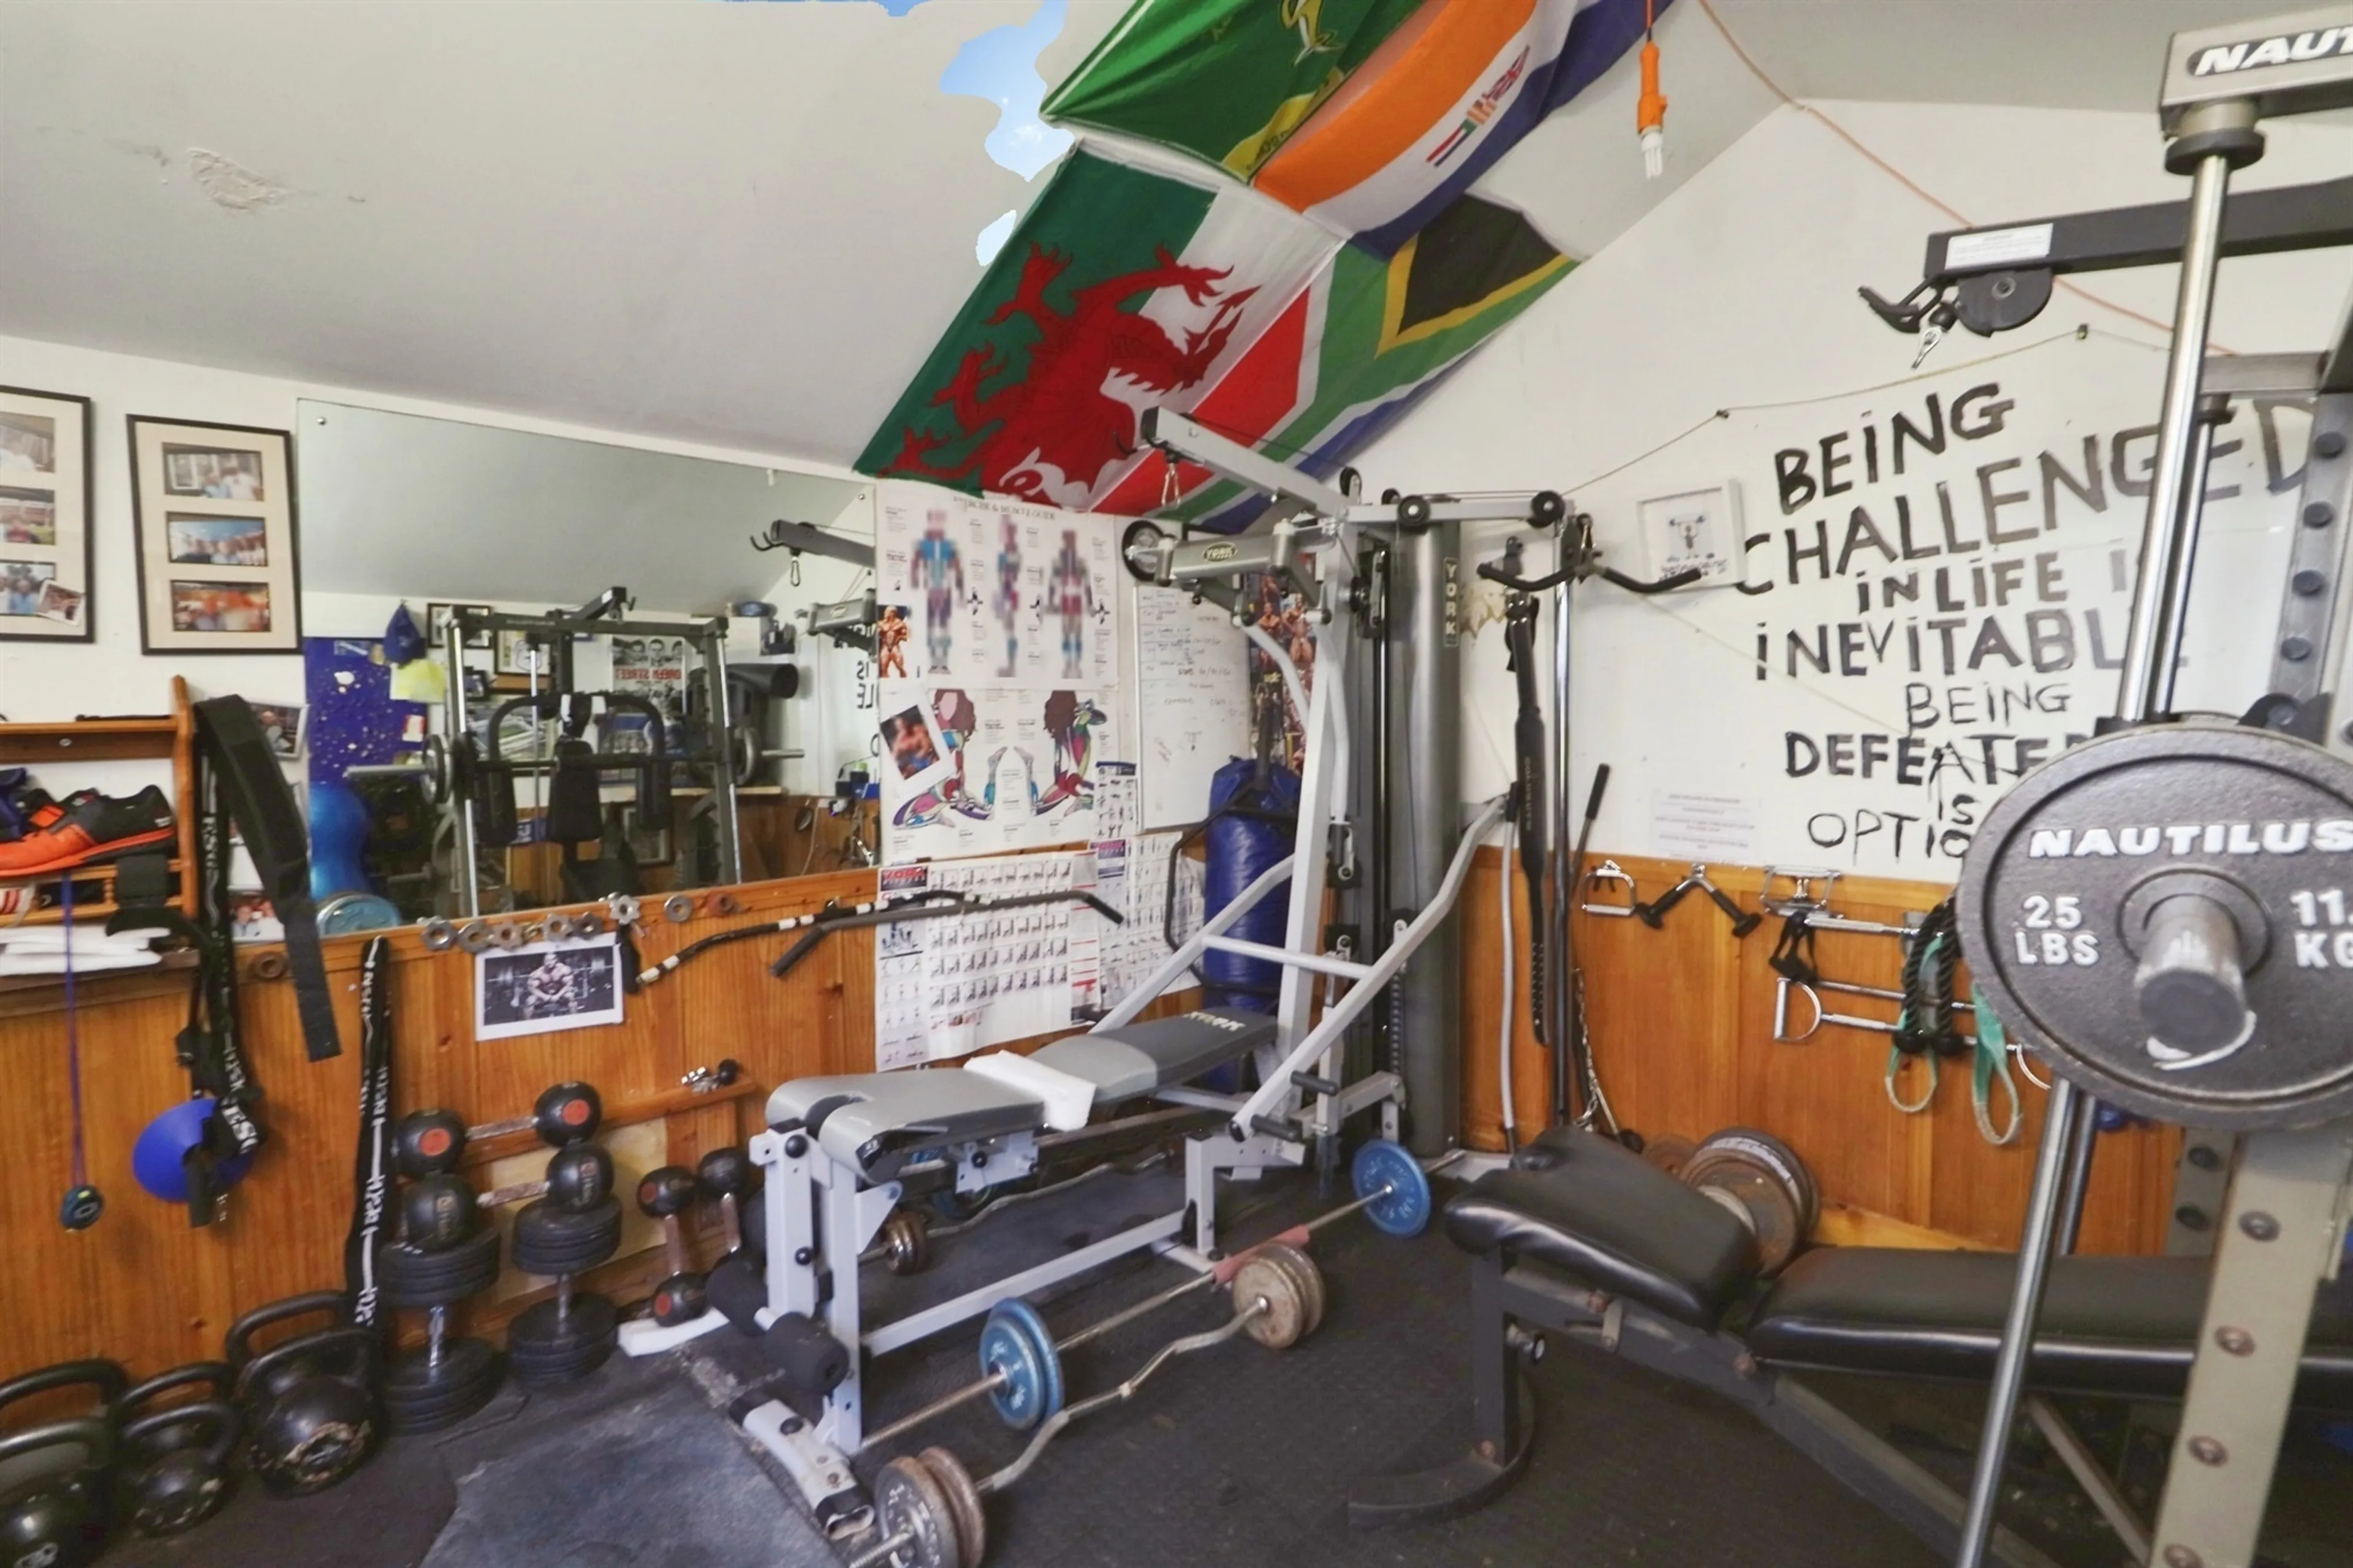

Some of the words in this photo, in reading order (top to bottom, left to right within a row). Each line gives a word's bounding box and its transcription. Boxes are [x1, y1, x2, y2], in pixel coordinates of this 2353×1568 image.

[2109, 538, 2131, 593] I
[1445, 562, 1458, 635] YORK
[1757, 604, 2188, 680] INEVITABL
[1786, 732, 2090, 786] DEFEATE
[2029, 820, 2353, 858] NAUTILUS
[2024, 895, 2082, 930] 25
[2015, 931, 2099, 966] LBS
